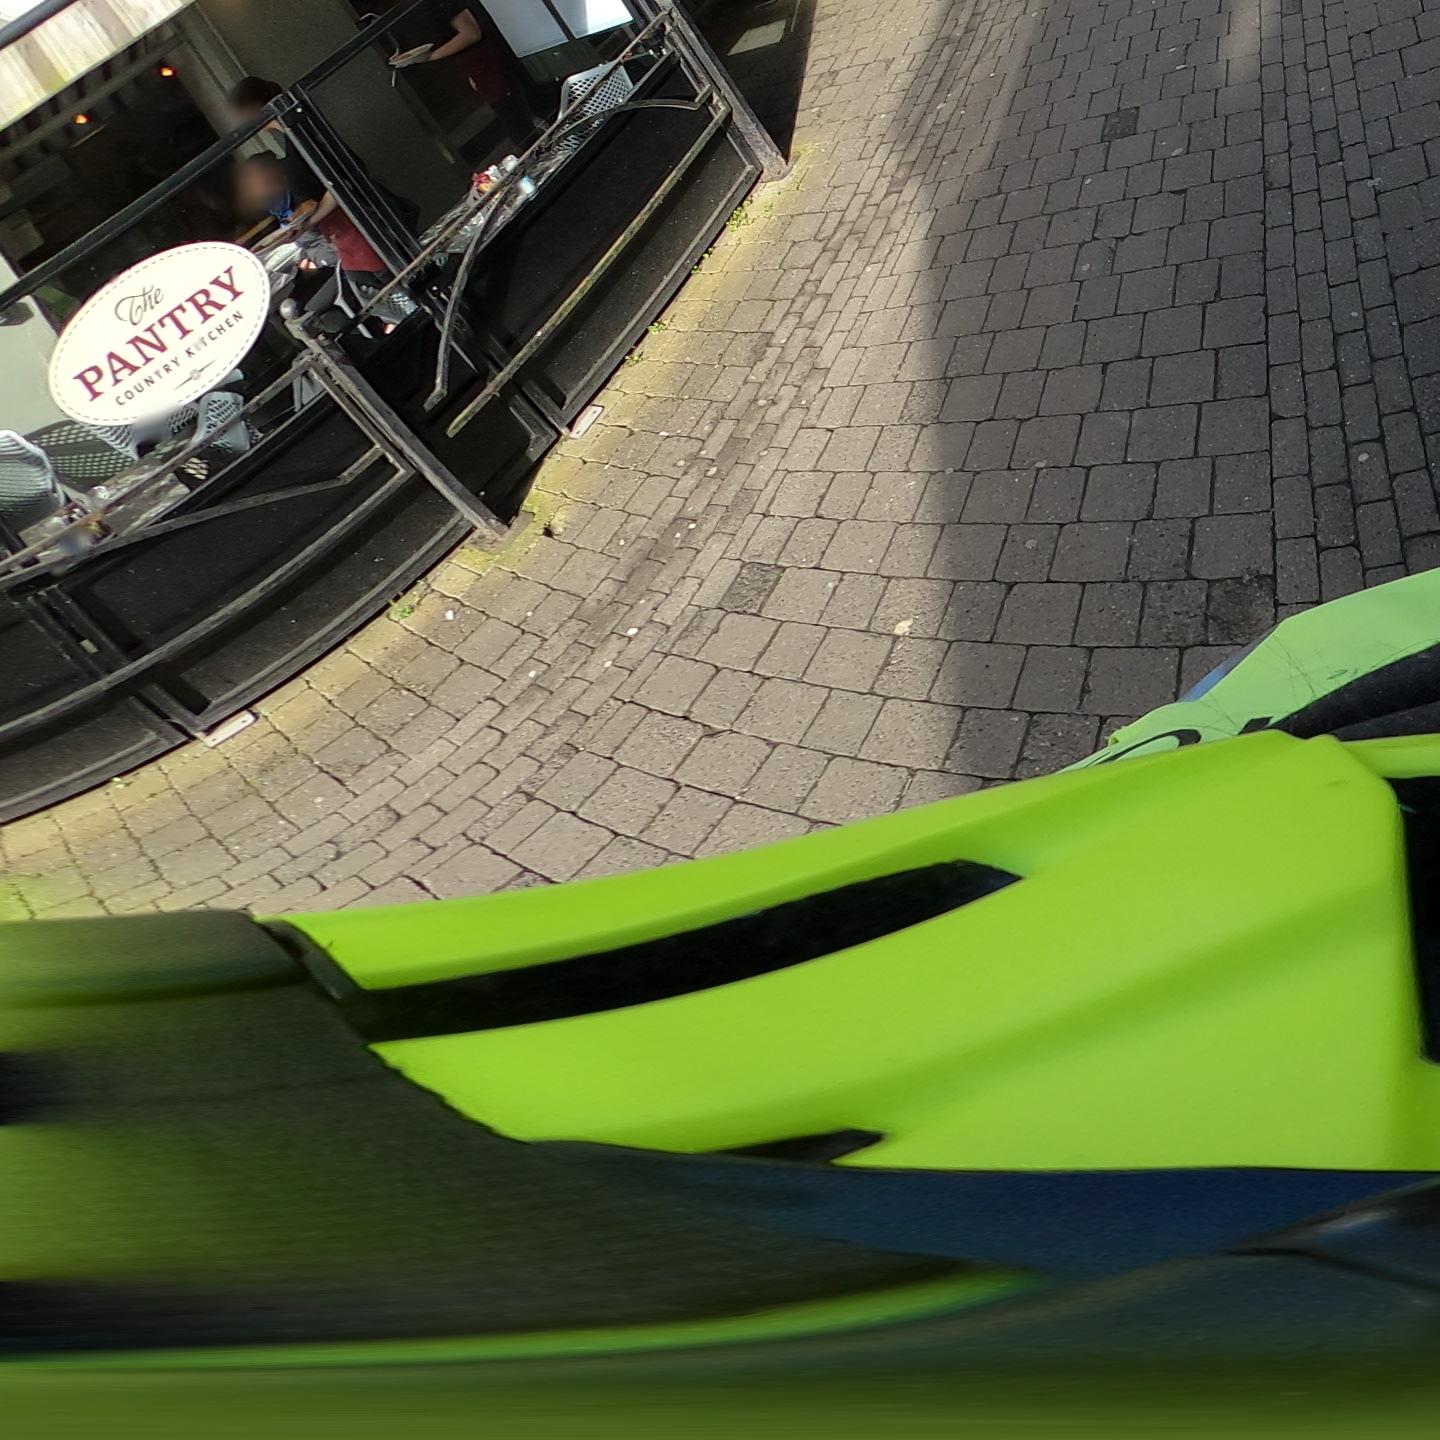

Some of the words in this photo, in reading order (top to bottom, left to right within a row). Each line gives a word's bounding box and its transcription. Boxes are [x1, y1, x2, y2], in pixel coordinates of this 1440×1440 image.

[72, 265, 245, 402] PANTRY
[114, 283, 165, 326] The
[115, 356, 181, 406] COUNTRY
[185, 310, 244, 358] KTCHEN
